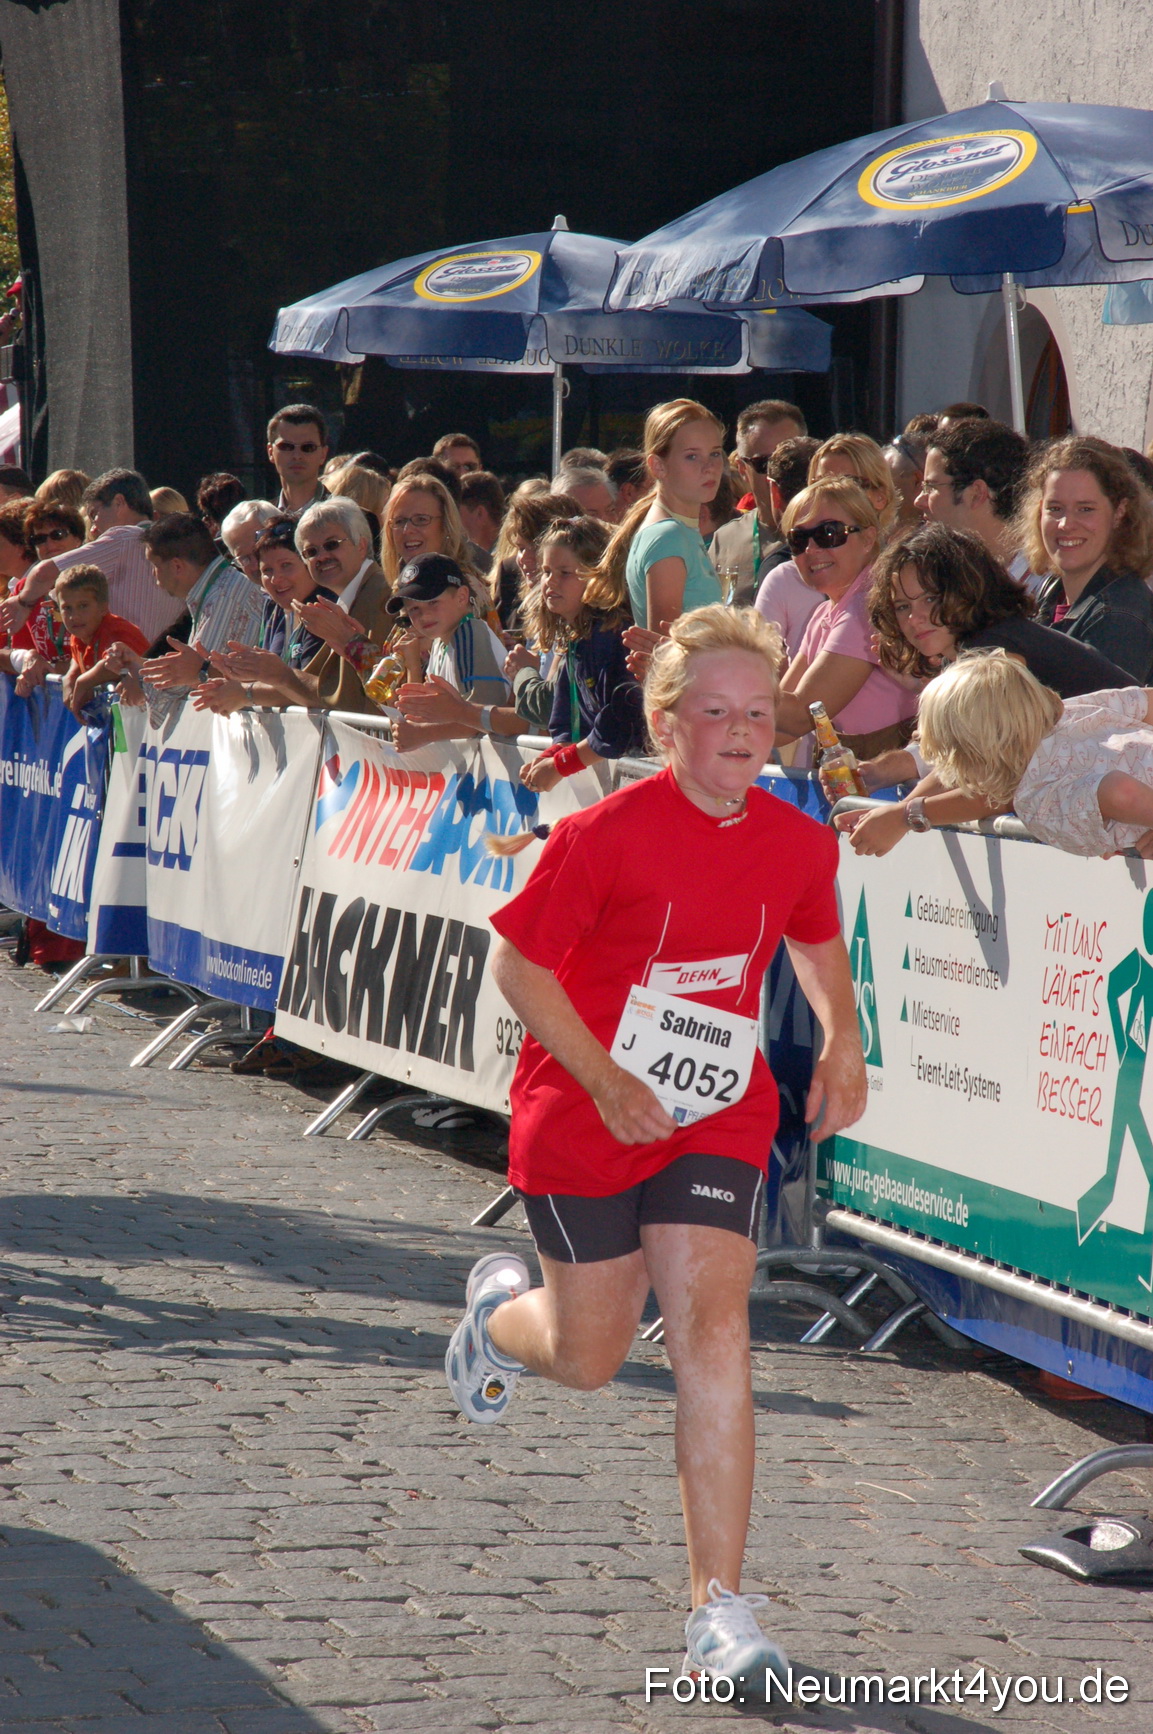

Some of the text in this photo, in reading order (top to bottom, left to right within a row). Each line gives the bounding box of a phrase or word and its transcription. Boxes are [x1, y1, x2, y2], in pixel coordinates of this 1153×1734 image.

[885, 142, 1011, 183] Glossner
[564, 335, 643, 358] DUNKLE
[656, 340, 726, 360] WOLKE
[327, 757, 540, 893] INTERSPORT
[916, 894, 999, 942] Gebäudereinigung
[1072, 918, 1107, 963] UNS
[277, 885, 490, 1073] HACKNER
[677, 967, 721, 985] DEHN
[914, 947, 999, 991] Hausmeisterdienste
[660, 1009, 732, 1049] Sabrina
[911, 1000, 961, 1037] Mietservice
[622, 1033, 637, 1051] J
[647, 1052, 739, 1103] 4052
[916, 1054, 1001, 1103] Event-Leit-Systeme
[691, 1184, 735, 1203] JAKO
[825, 1157, 970, 1229] www.jura-gebaeudeservice.de
